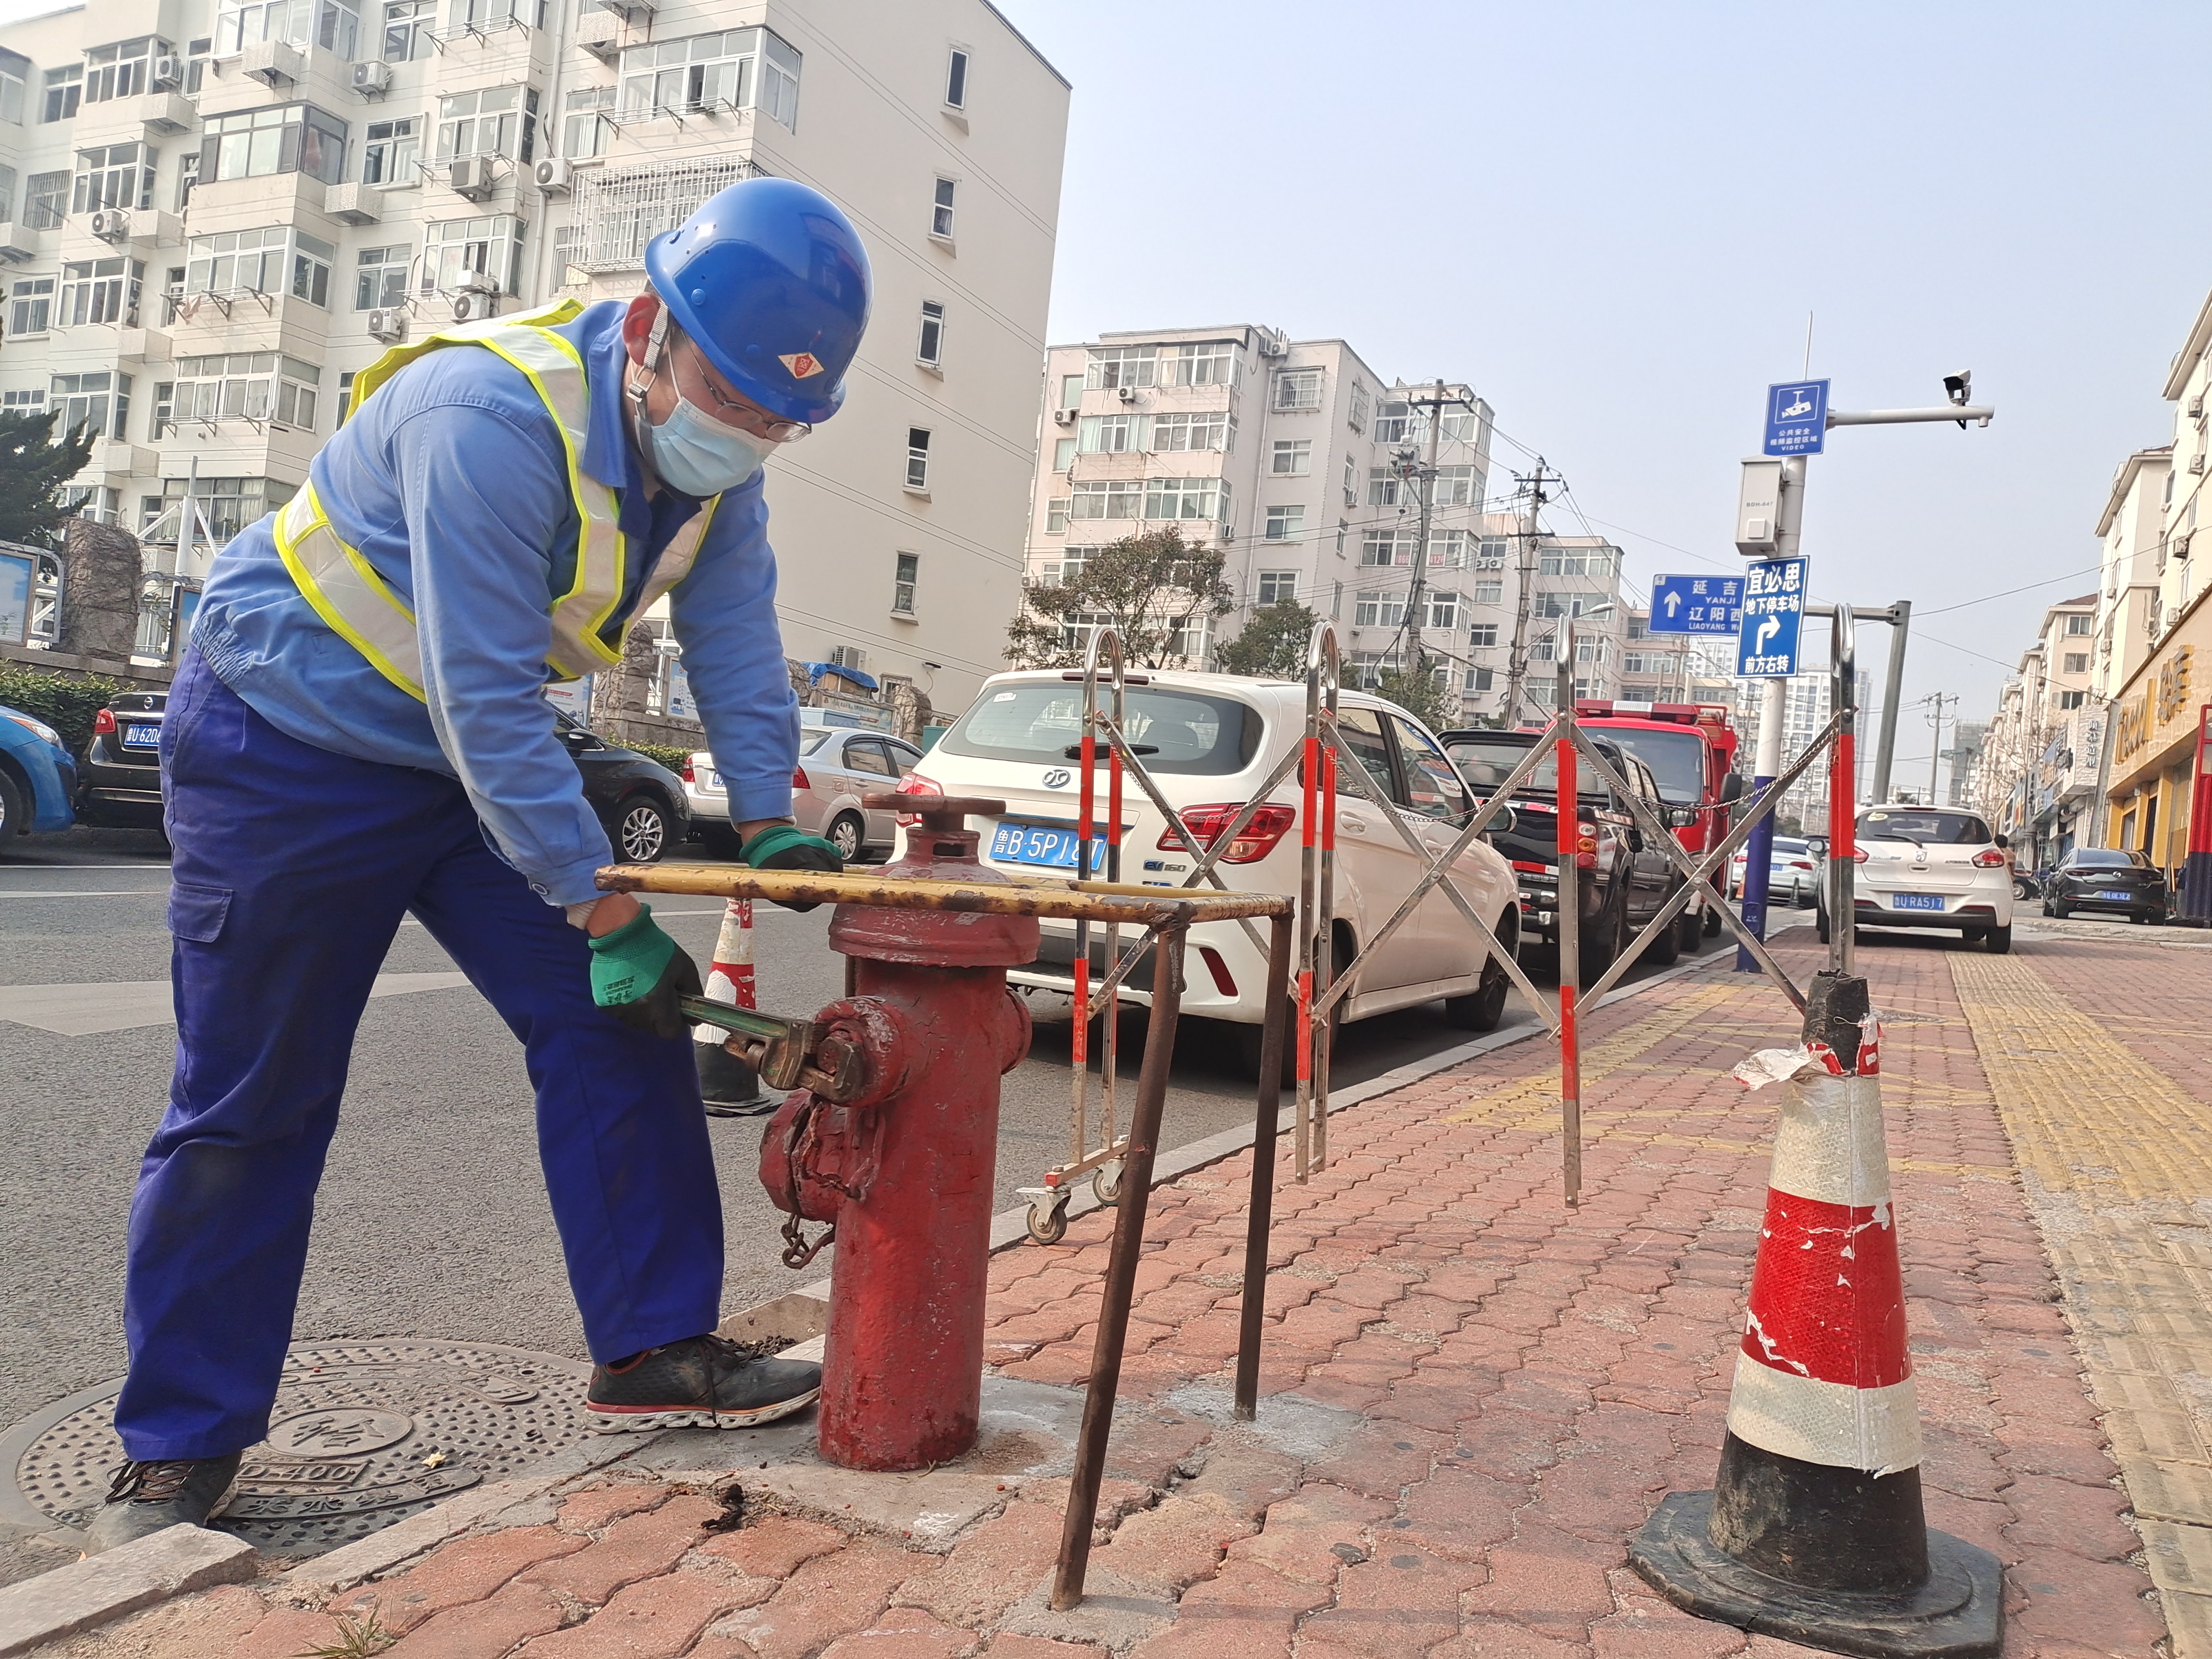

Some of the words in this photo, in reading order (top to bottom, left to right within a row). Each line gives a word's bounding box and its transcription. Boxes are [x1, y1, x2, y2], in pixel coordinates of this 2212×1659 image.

[1778, 428, 1810, 436] 公共安全
[1747, 562, 1800, 595] 宜必思
[1692, 580, 1738, 596] 延吉
[1745, 594, 1799, 615] 地下停车场
[1689, 622, 1726, 630] LIAOYANG
[1745, 654, 1789, 674] 前方右转
